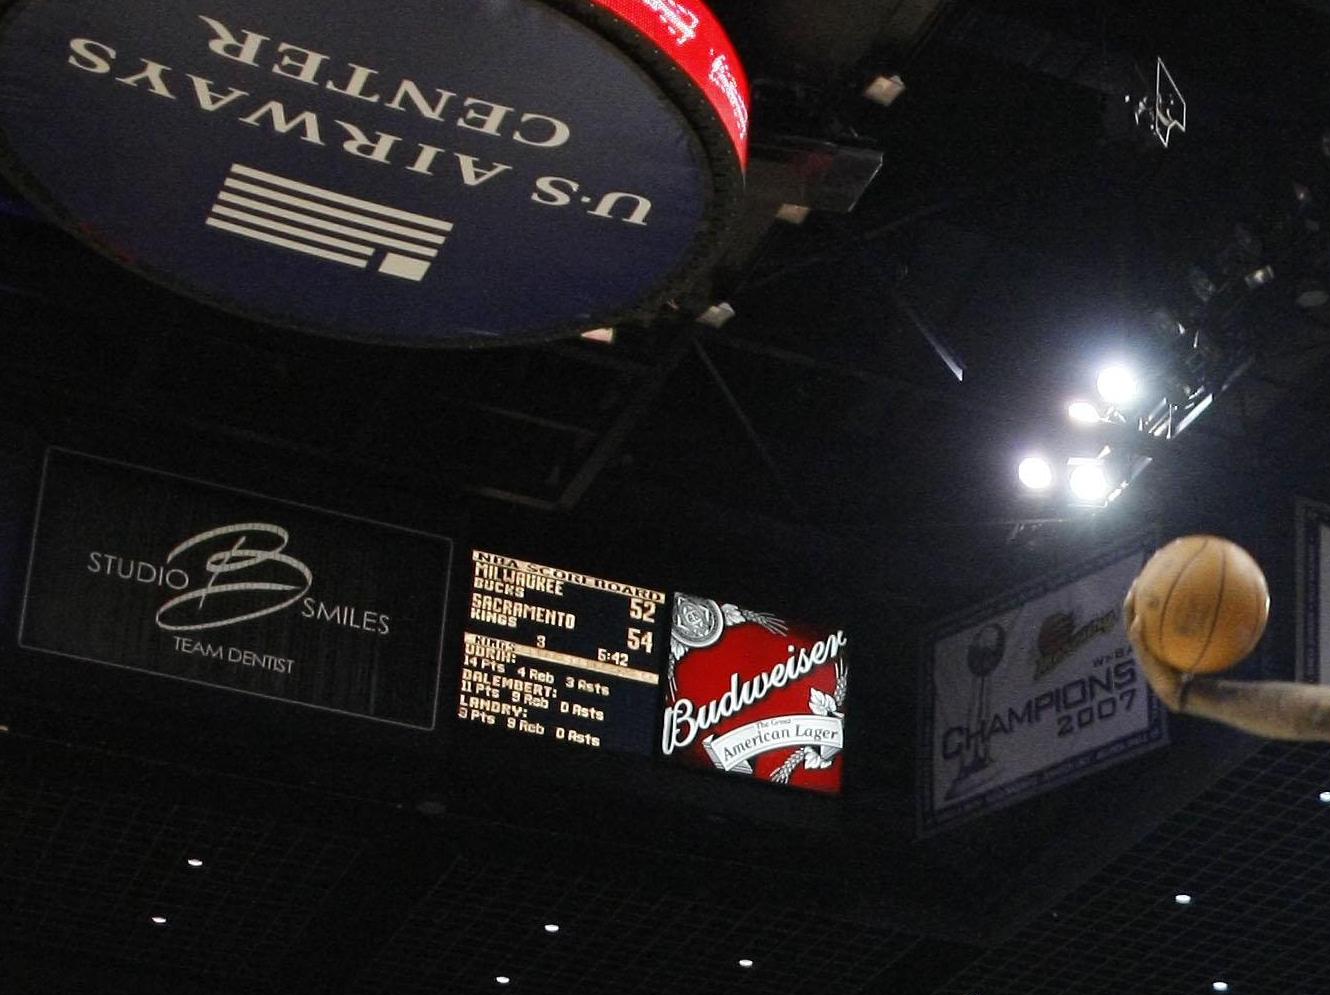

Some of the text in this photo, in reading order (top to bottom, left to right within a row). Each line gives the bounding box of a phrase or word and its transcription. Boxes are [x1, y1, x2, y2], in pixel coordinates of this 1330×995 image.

[199, 15, 571, 149] CENTER
[66, 37, 513, 187] AIRWAYS
[87, 551, 190, 591] STUDIO
[473, 576, 525, 599] BUCKS
[475, 561, 564, 597] MILWAUKEE
[301, 597, 391, 635] SMILES
[470, 607, 518, 629] KINGS
[472, 592, 576, 630] SACRAMENTO
[629, 598, 657, 624] 52
[174, 635, 296, 675] TEAM DENTIST
[626, 627, 653, 654] 54
[662, 630, 848, 756] Budweiser
[942, 659, 1138, 761] CHAMPIONS
[1056, 688, 1138, 738] 2007
[722, 723, 839, 762] American Lager
